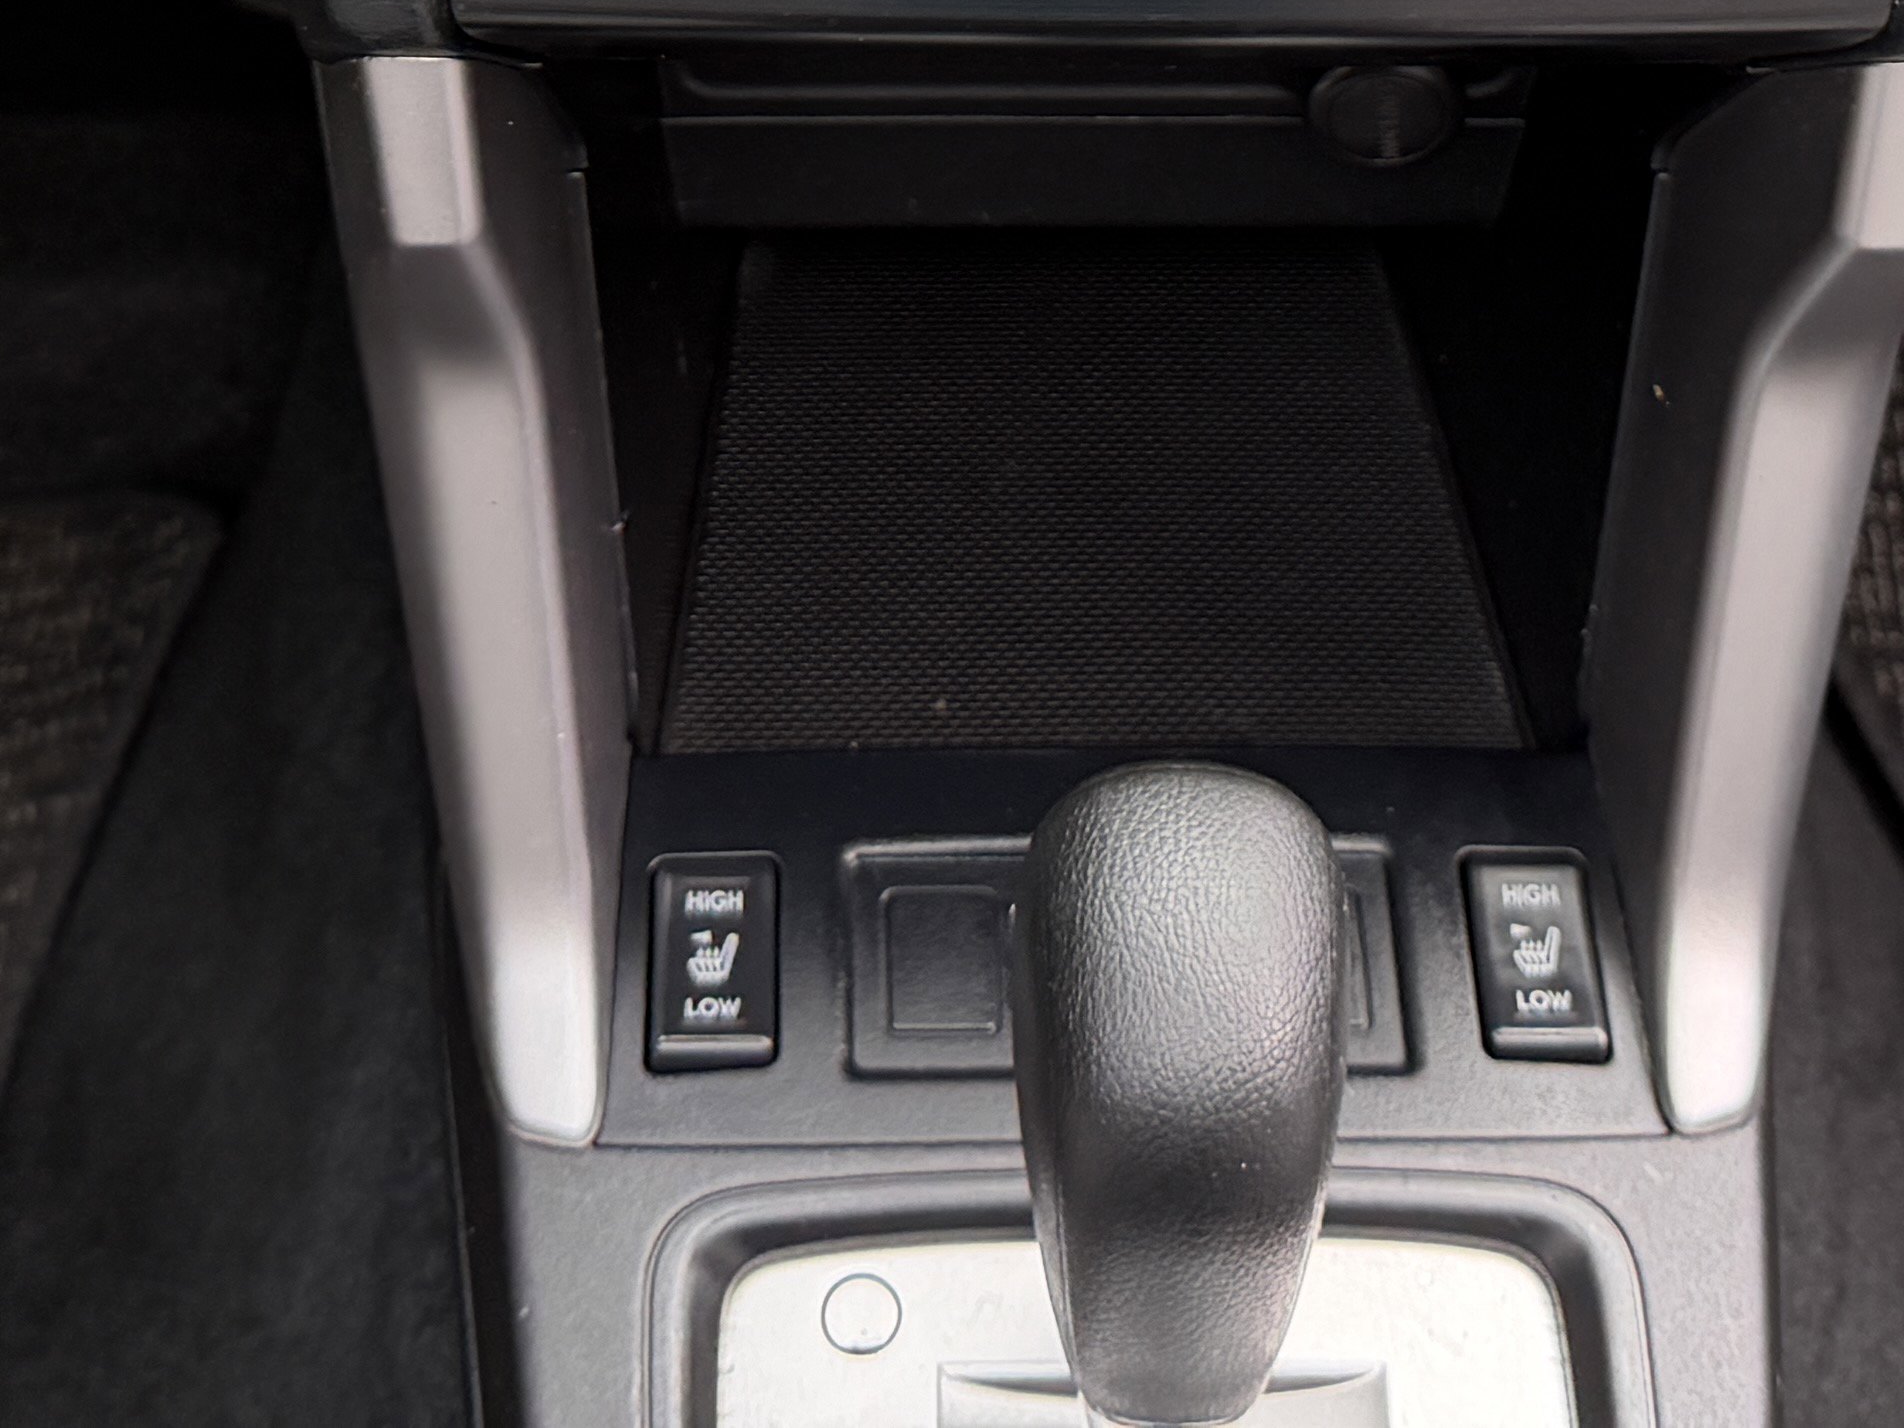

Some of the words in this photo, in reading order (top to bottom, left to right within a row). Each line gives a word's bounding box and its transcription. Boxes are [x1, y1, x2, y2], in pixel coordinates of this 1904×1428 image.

[684, 889, 744, 915] HIGH
[1501, 883, 1560, 906] HIGH
[683, 996, 742, 1020] LOW
[1516, 989, 1572, 1012] LOW
